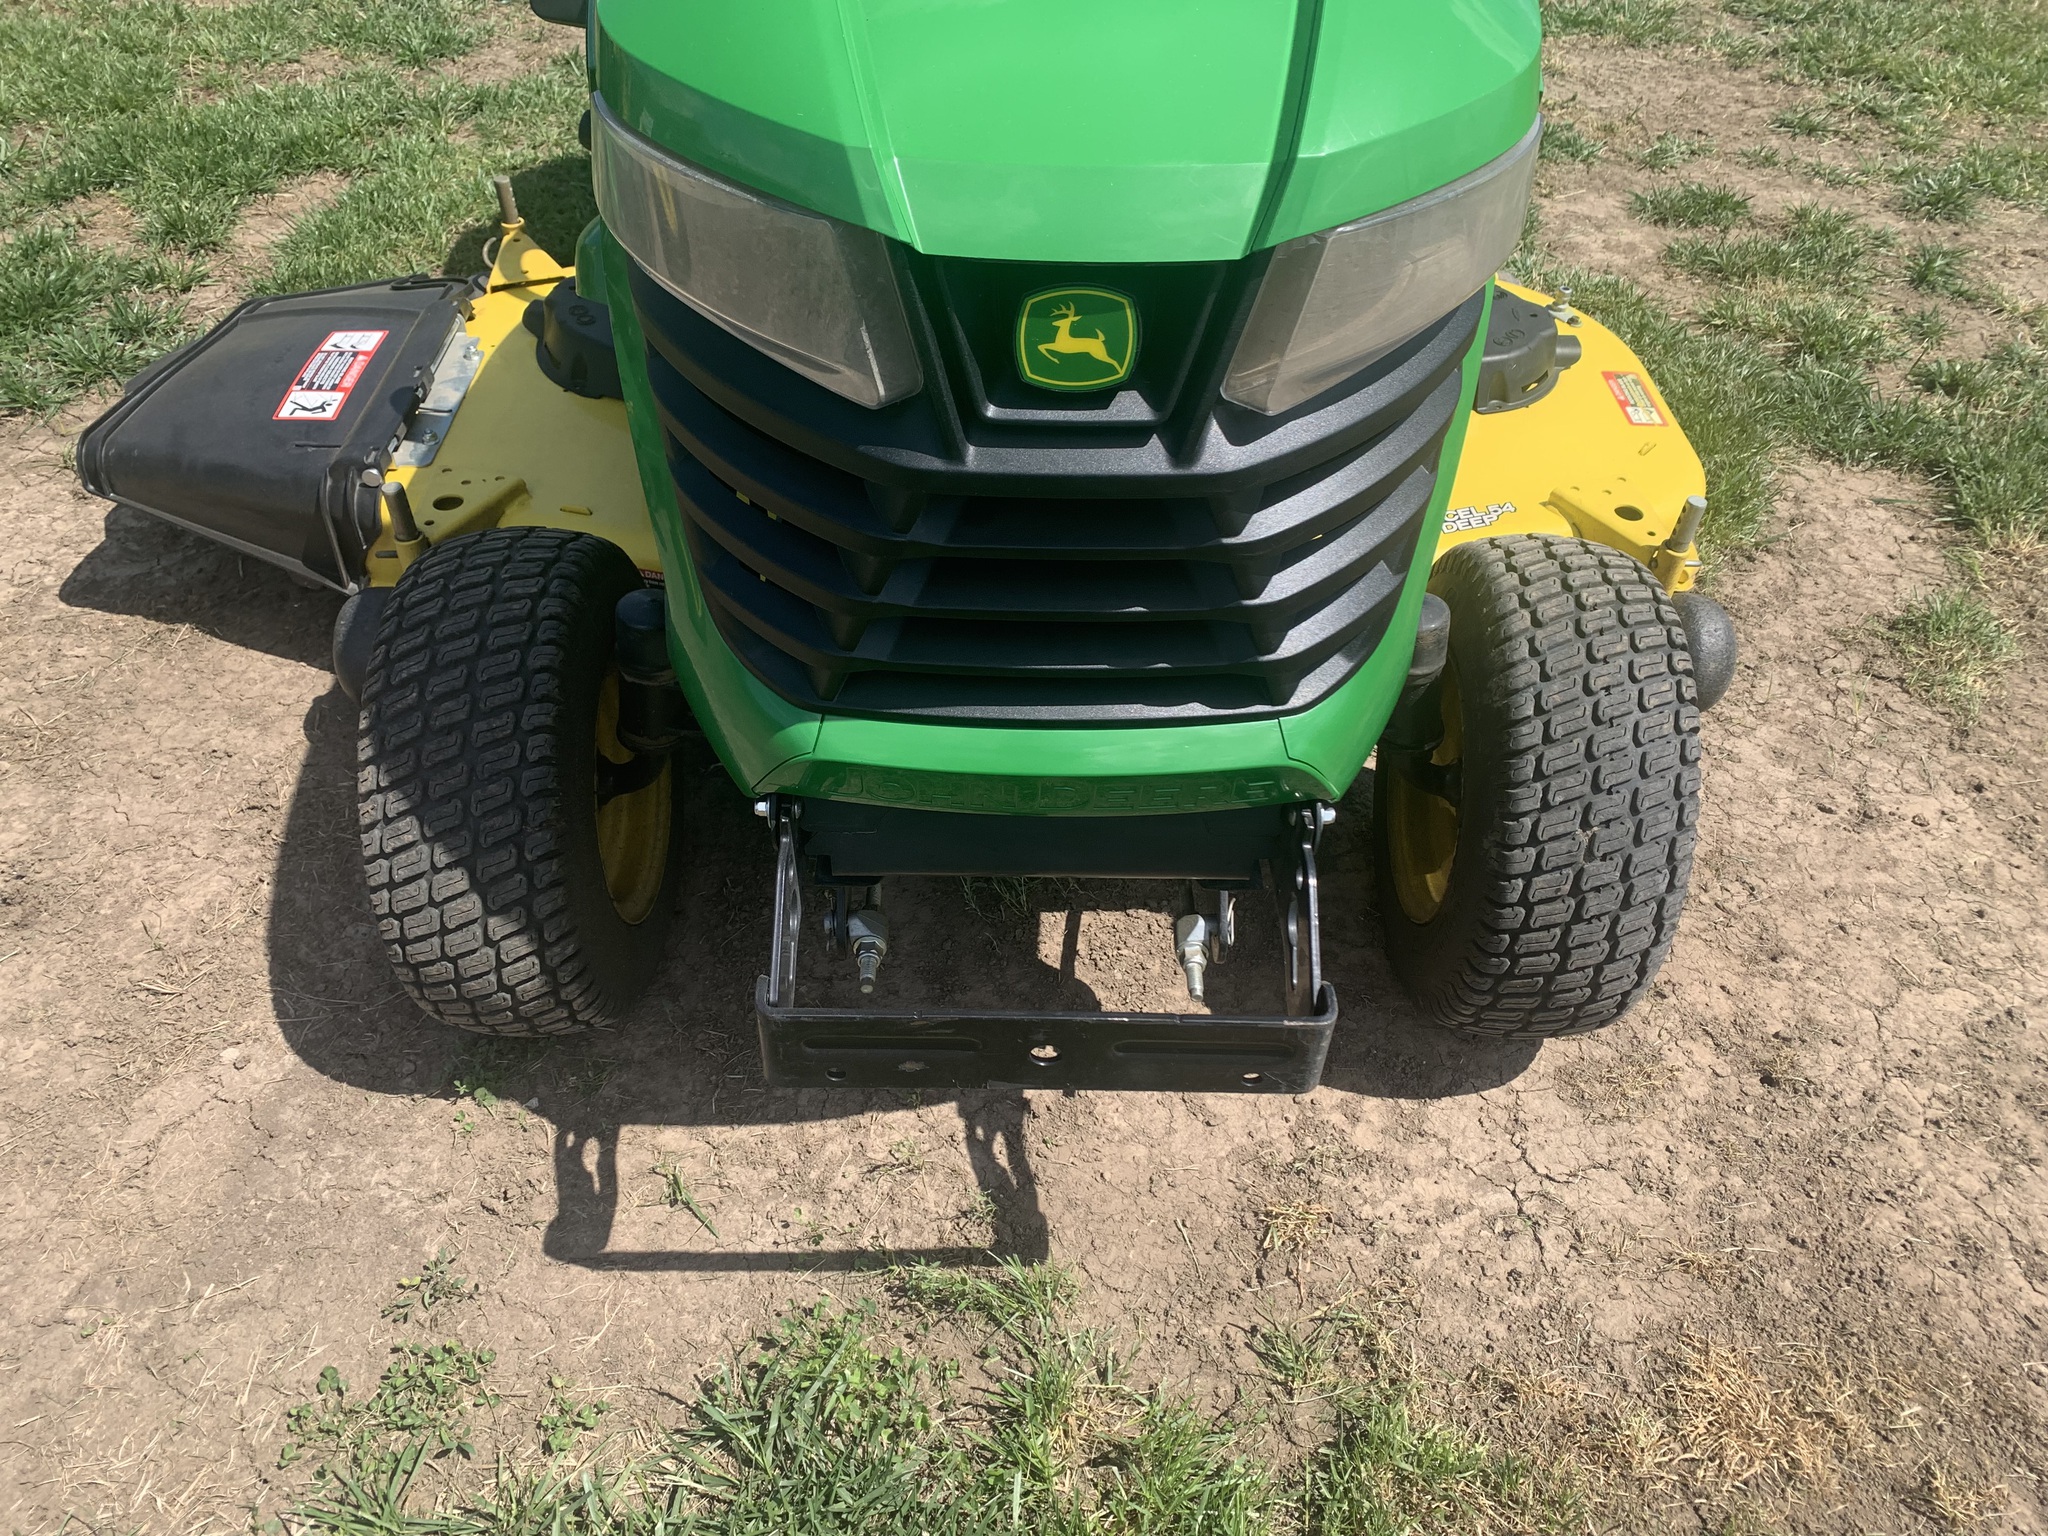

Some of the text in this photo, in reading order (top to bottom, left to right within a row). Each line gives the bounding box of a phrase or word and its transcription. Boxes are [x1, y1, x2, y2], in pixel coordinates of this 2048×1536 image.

[1441, 514, 1500, 535] DEEP
[819, 767, 1276, 811] JOHN DEERE
